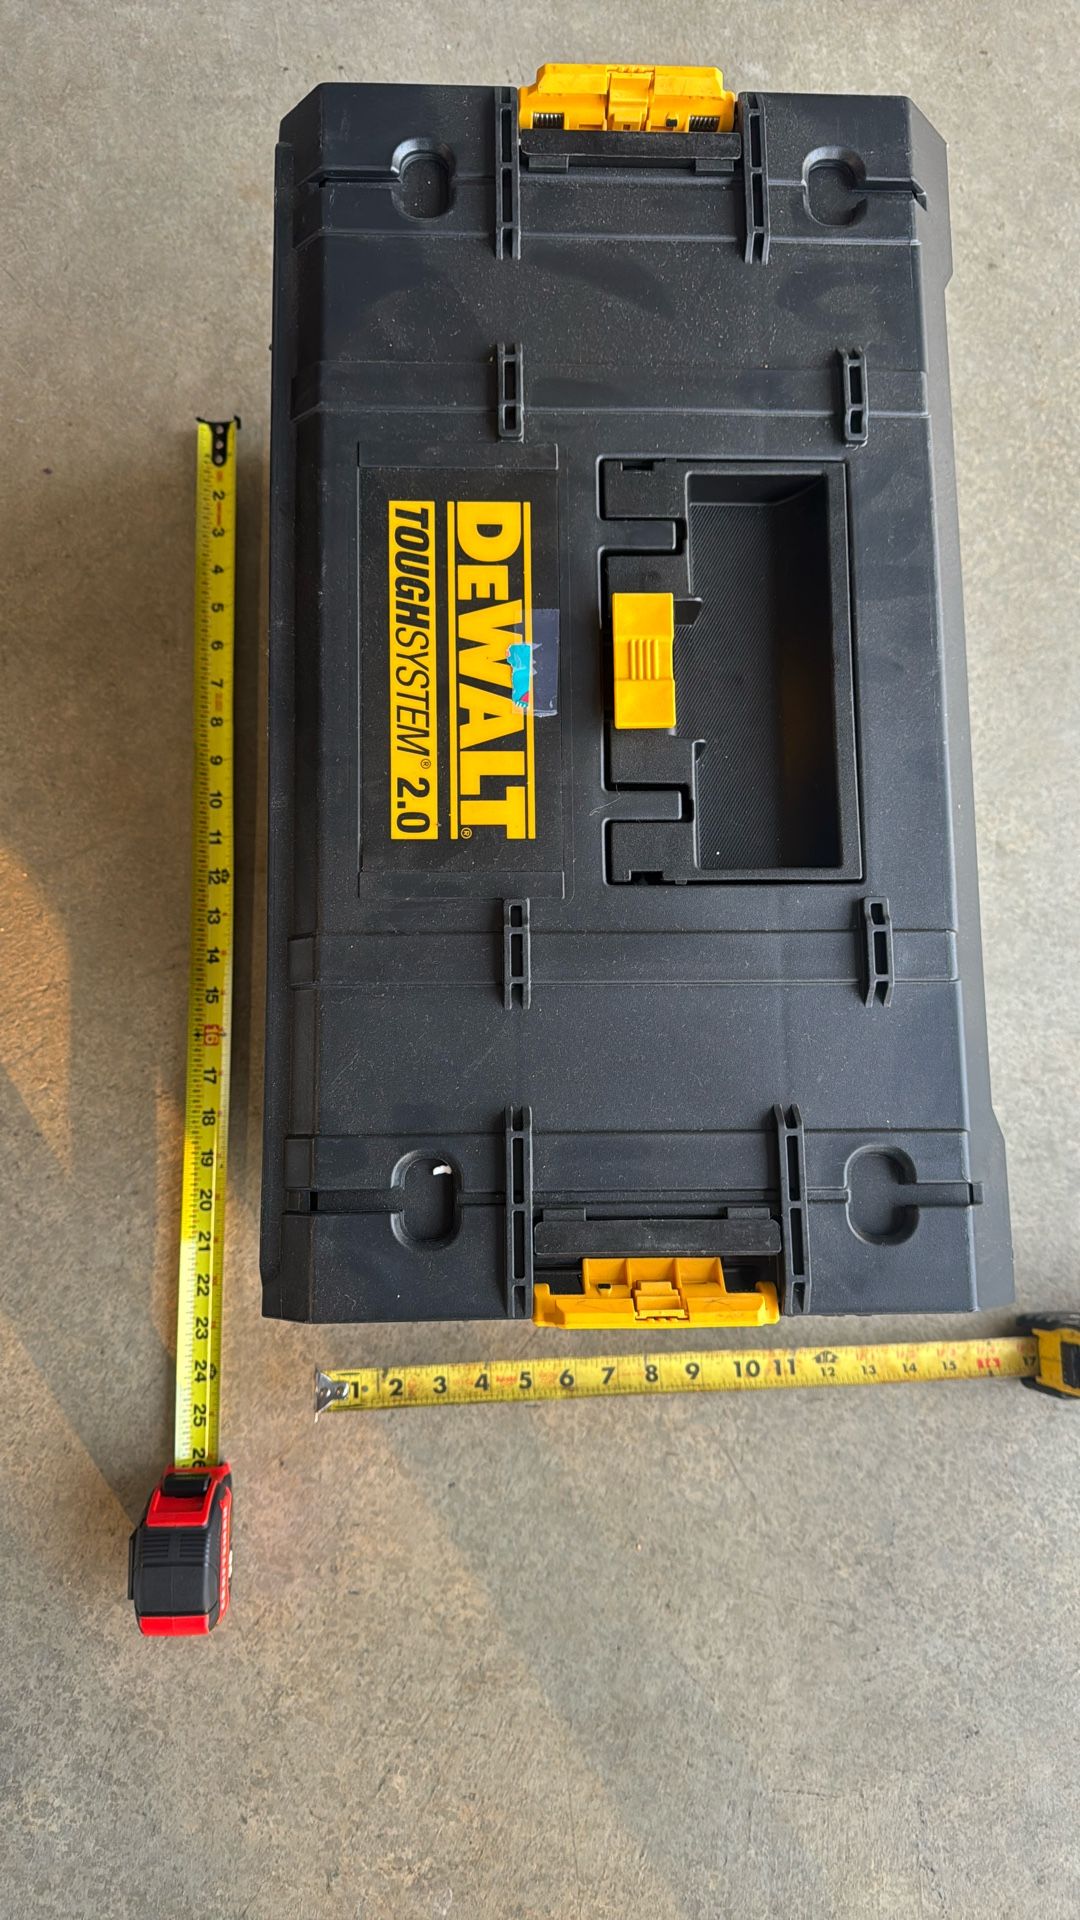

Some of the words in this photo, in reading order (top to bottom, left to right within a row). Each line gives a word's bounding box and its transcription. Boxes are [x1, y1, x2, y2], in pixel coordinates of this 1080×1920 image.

[212, 490, 225, 501] 2
[212, 527, 225, 538] 3
[212, 564, 224, 574] 4
[212, 602, 224, 613] 5
[211, 640, 224, 650] 6
[211, 678, 223, 689] 7
[210, 716, 223, 727] 8
[210, 755, 223, 766] 9
[209, 790, 222, 809] 10
[396, 777, 431, 834] 2.0
[209, 829, 222, 845] 11
[208, 868, 221, 885] 12
[207, 907, 220, 925] 13
[207, 947, 220, 964] 14
[206, 986, 219, 1004] 15
[205, 1026, 218, 1044] 16
[203, 1066, 217, 1084] 17
[202, 1107, 216, 1126] 18
[201, 1149, 214, 1167] 19
[199, 1189, 213, 1211] 20
[198, 1230, 211, 1252] 21
[197, 1273, 210, 1297] 22
[195, 1316, 209, 1340] 23
[194, 1359, 207, 1383] 24
[350, 1381, 359, 1399] 1
[389, 1378, 404, 1396] 2
[433, 1376, 447, 1394] 3
[474, 1373, 490, 1391] 4
[518, 1371, 532, 1390] 5
[559, 1369, 574, 1387] 6
[601, 1366, 616, 1385] 7
[645, 1364, 659, 1382] 8
[685, 1362, 700, 1380] 9
[733, 1360, 761, 1377] 10
[773, 1358, 796, 1376] 11
[193, 1404, 207, 1427] 25
